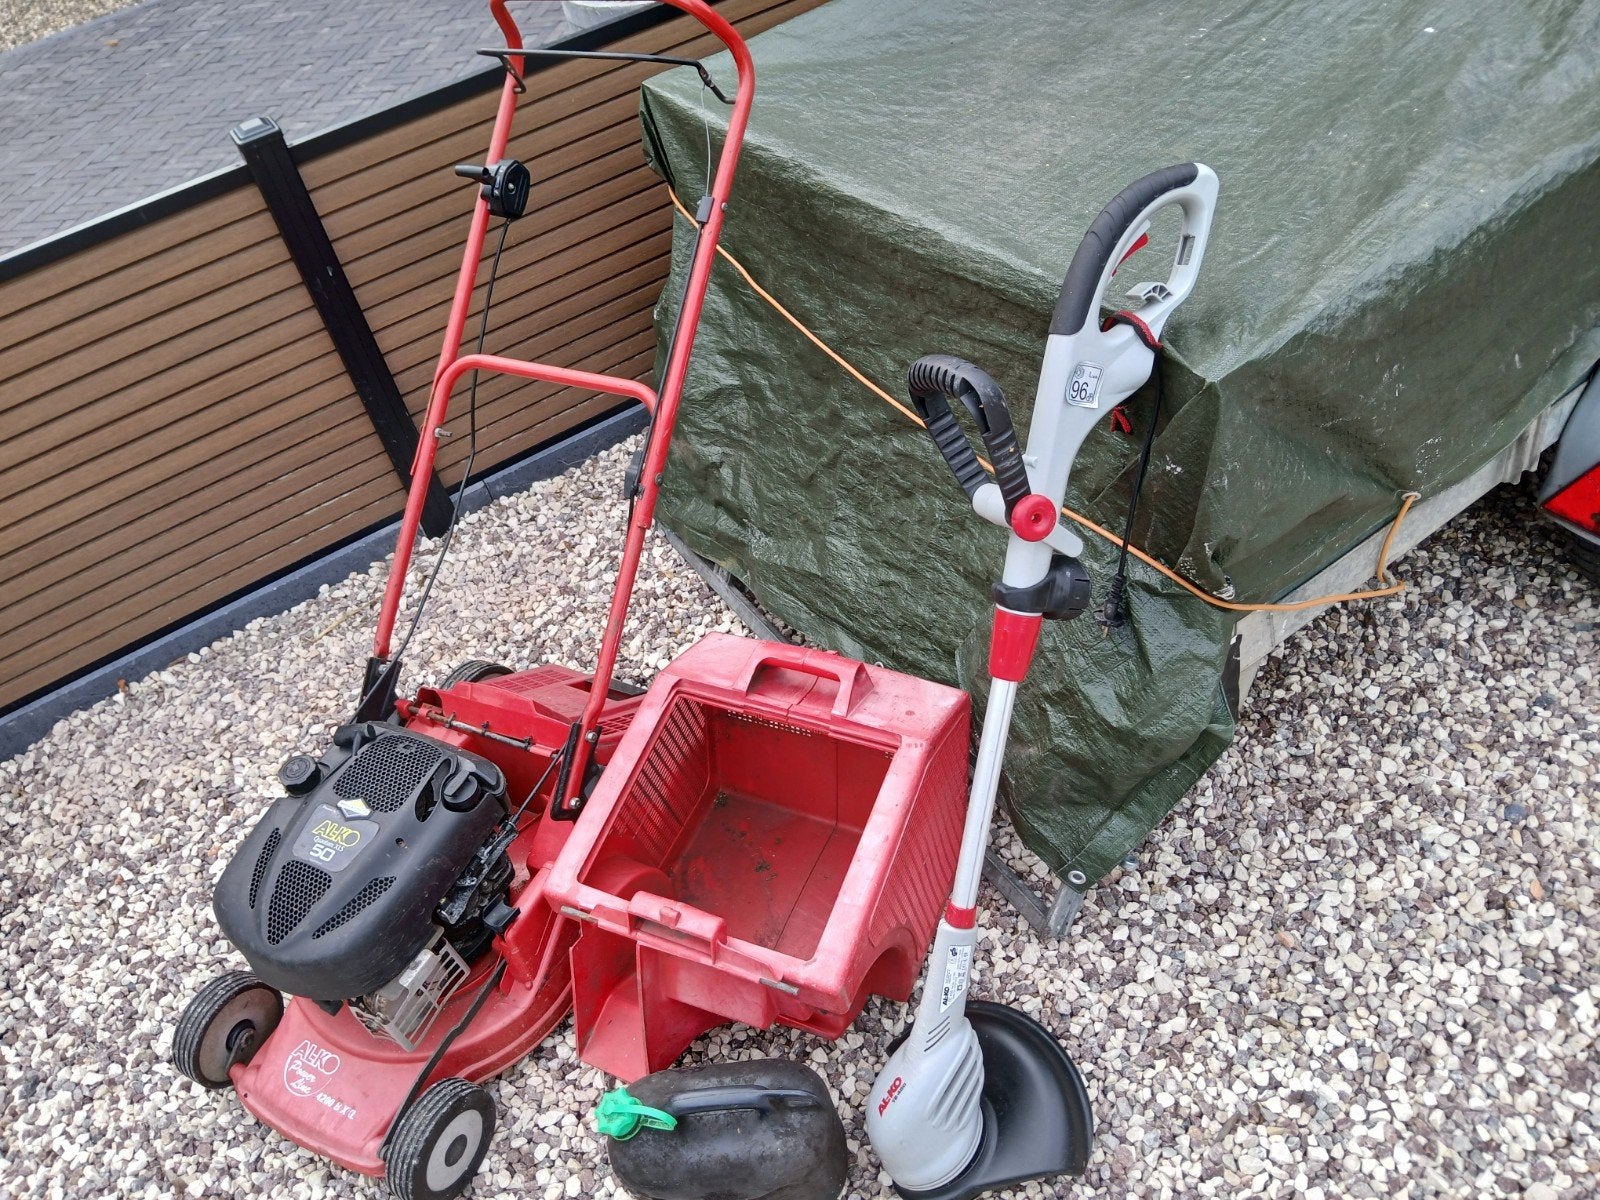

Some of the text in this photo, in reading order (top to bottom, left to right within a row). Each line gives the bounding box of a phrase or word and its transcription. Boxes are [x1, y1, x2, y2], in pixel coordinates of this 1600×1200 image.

[1071, 380, 1089, 400] 96
[312, 820, 360, 847] AL-KO
[309, 843, 336, 861] 50
[942, 986, 950, 1005] AL-KO
[290, 1040, 340, 1075] AL-KO
[288, 1060, 317, 1083] Power
[290, 1077, 312, 1094] Line
[316, 1092, 336, 1108] 4200
[878, 1076, 902, 1117] AL-KO
